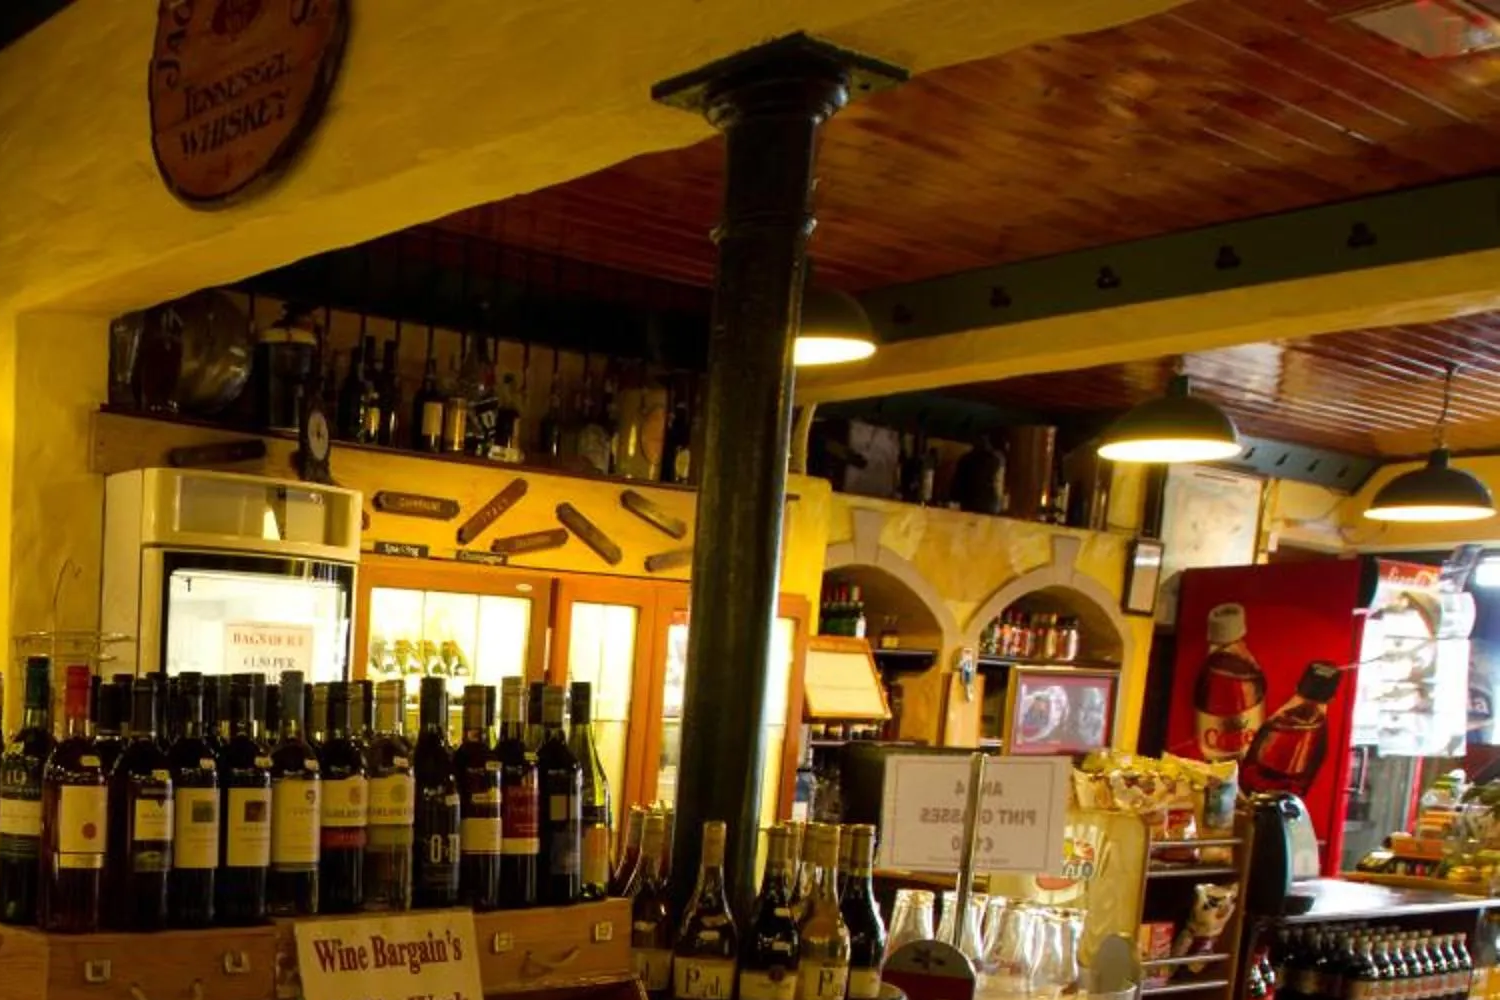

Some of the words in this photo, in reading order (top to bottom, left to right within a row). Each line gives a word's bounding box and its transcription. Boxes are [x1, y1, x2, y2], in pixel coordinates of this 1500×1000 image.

[180, 88, 290, 160] WHISKEY
[313, 938, 369, 973] Wine
[370, 930, 463, 975] Bargain's
